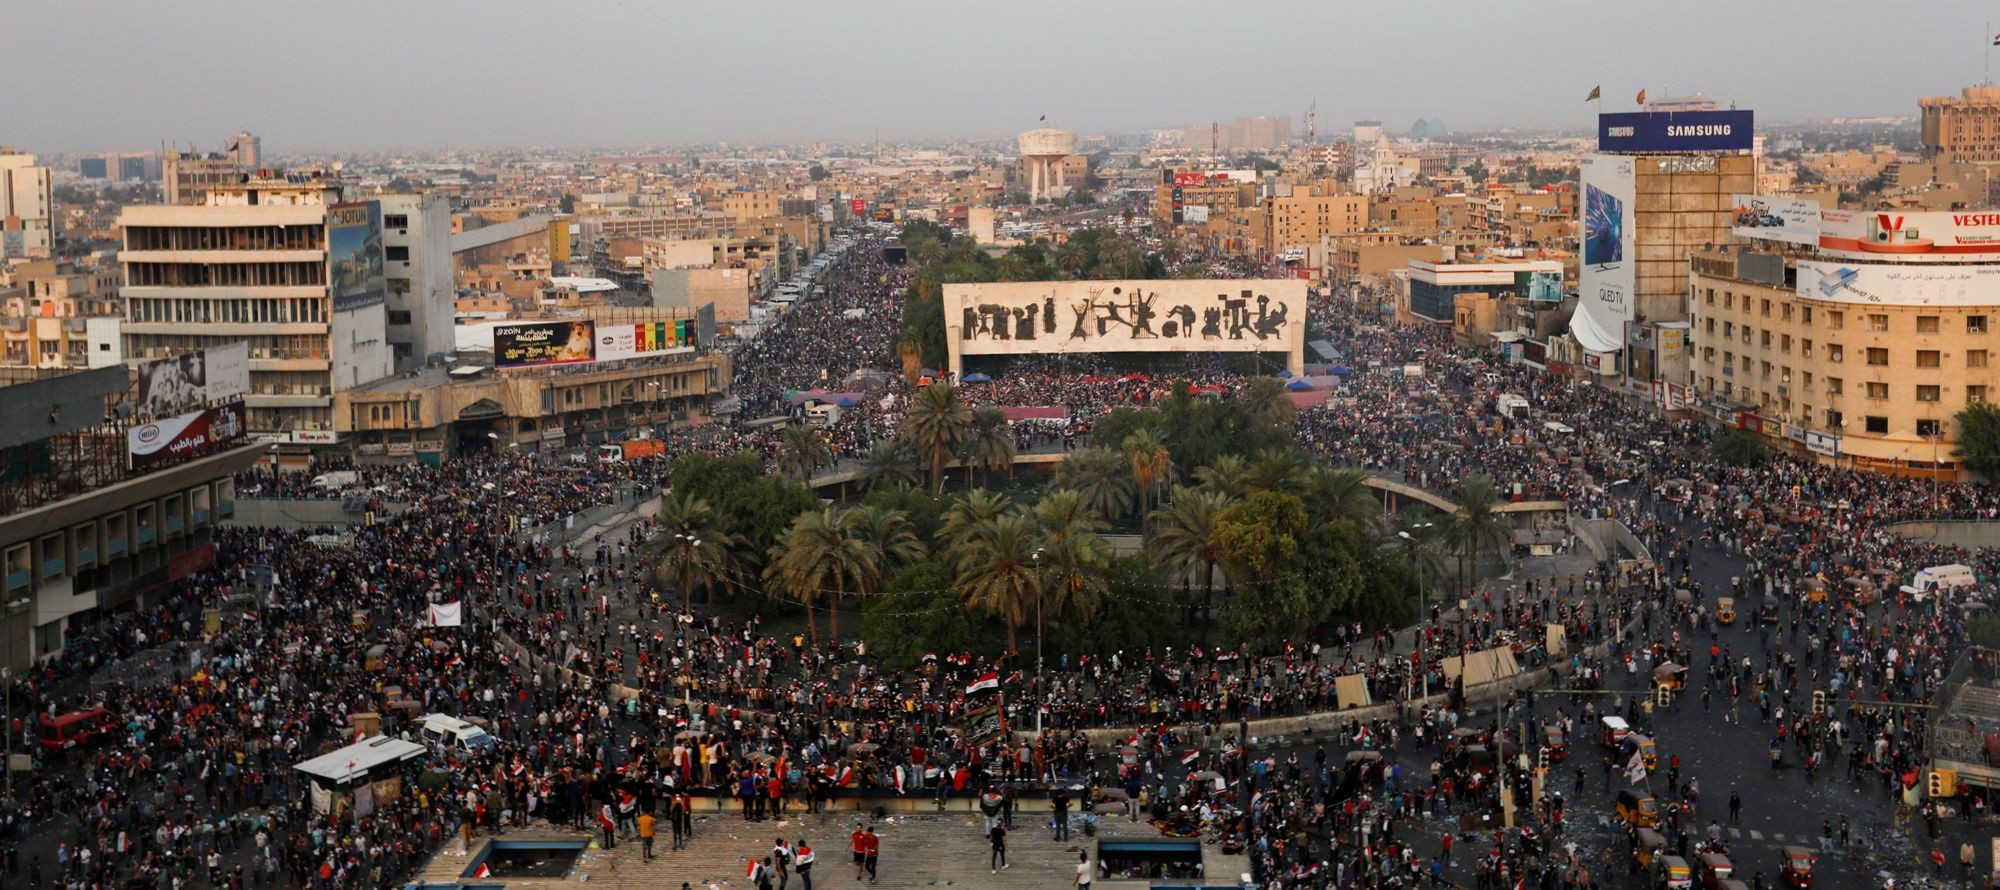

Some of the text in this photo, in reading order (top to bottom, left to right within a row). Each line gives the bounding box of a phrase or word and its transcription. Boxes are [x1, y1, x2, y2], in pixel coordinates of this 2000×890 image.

[1608, 126, 1635, 137] SAMSUNG
[1667, 124, 1731, 137] SAMSUNG
[341, 208, 367, 224] JOTUN
[1600, 288, 1624, 304] QLED TV
